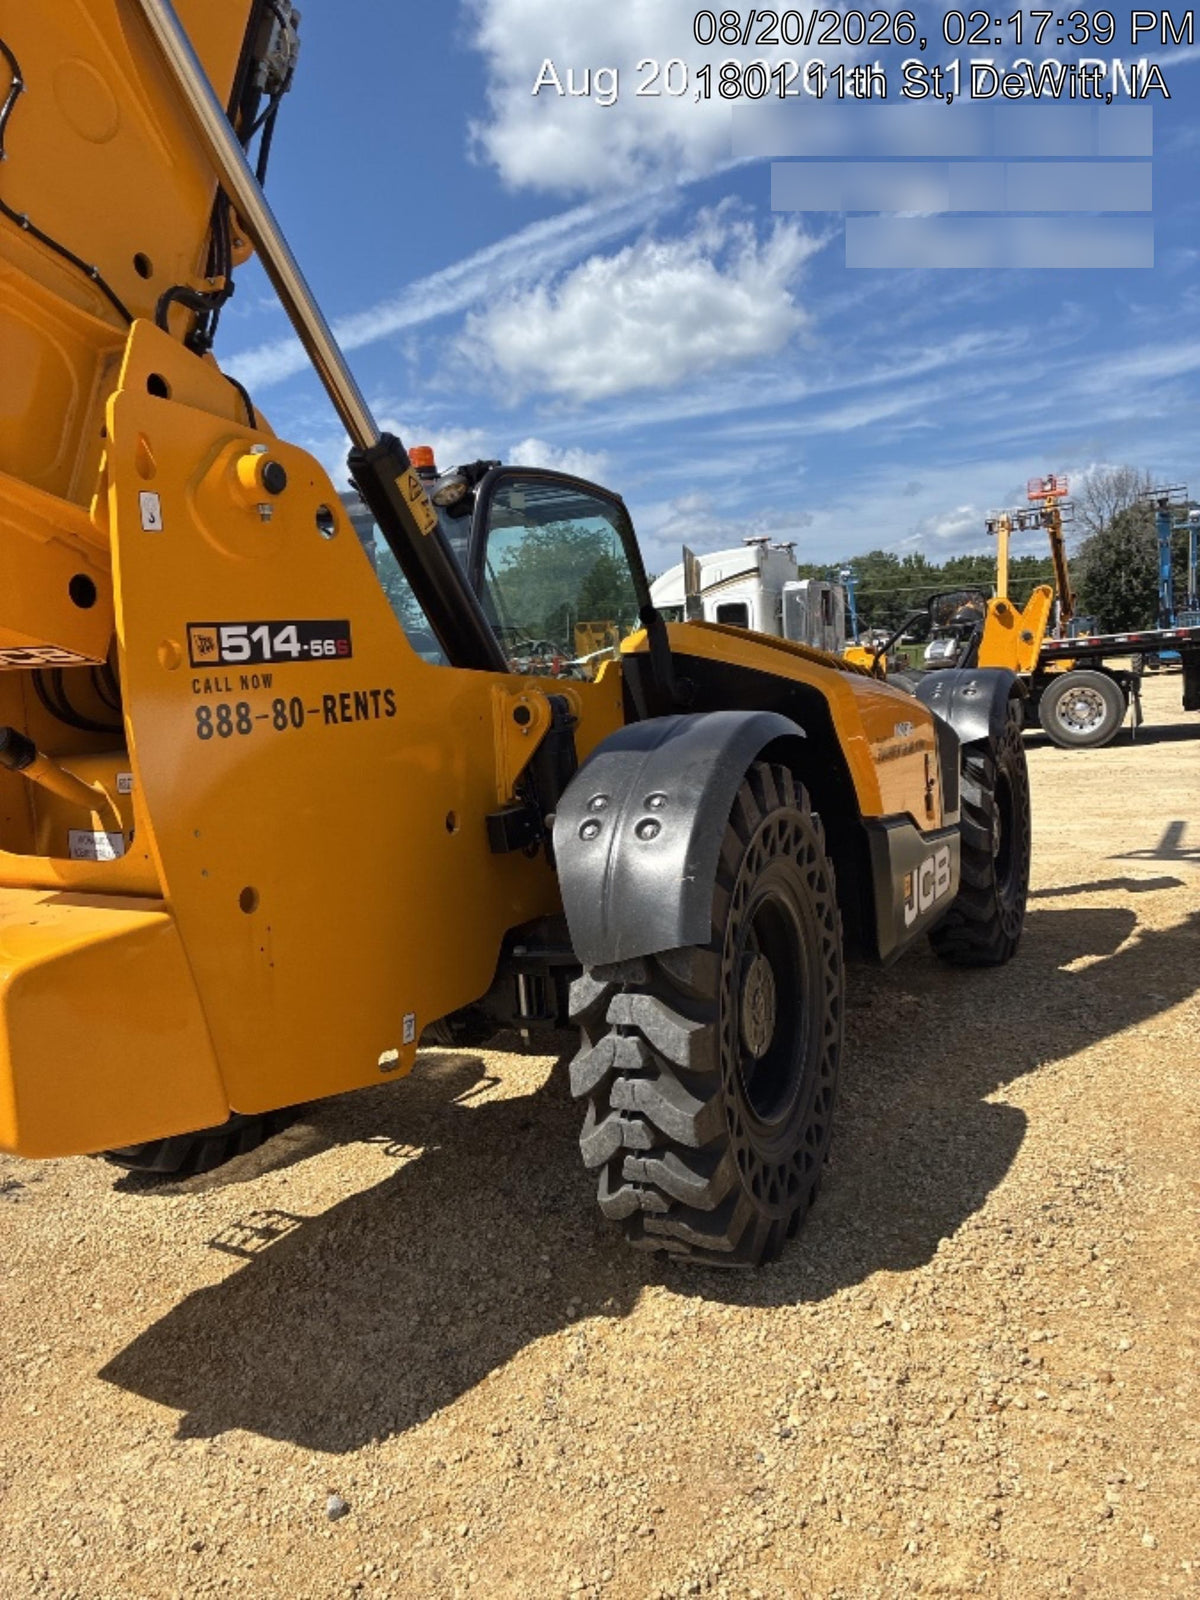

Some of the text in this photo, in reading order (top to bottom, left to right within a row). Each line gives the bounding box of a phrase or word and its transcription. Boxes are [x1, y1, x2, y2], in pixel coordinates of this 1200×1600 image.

[191, 673, 273, 694] CALL NOW
[195, 688, 398, 740] 888-80-RENTS
[904, 845, 952, 928] JCB
